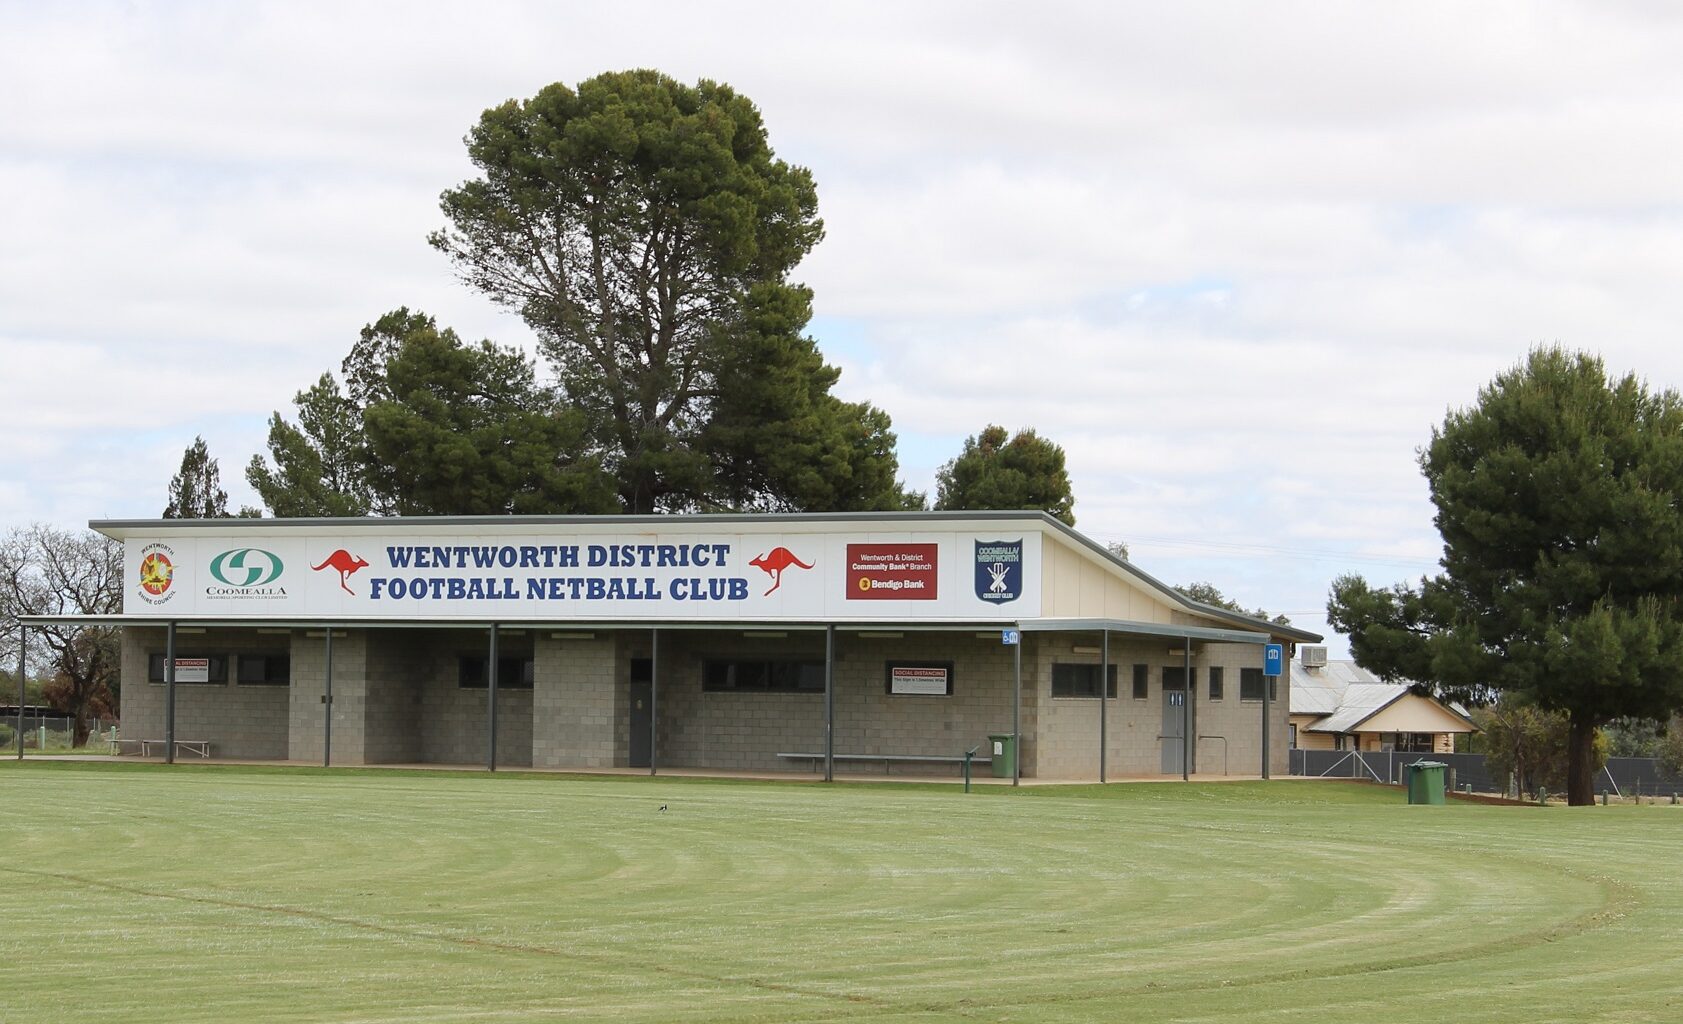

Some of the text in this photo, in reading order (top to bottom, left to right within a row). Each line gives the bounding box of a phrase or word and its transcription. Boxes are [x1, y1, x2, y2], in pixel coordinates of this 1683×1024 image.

[141, 542, 174, 556] WENTWORTH
[386, 544, 730, 568] WENTWORTH DISTRICT
[852, 563, 888, 571] Community
[206, 586, 287, 595] COOMEALLA
[370, 578, 748, 600] FOOTBALL NETBALL CLUB
[872, 580, 925, 590] Bendigo Bank
[138, 590, 177, 606] SHIRE COUNCIL
